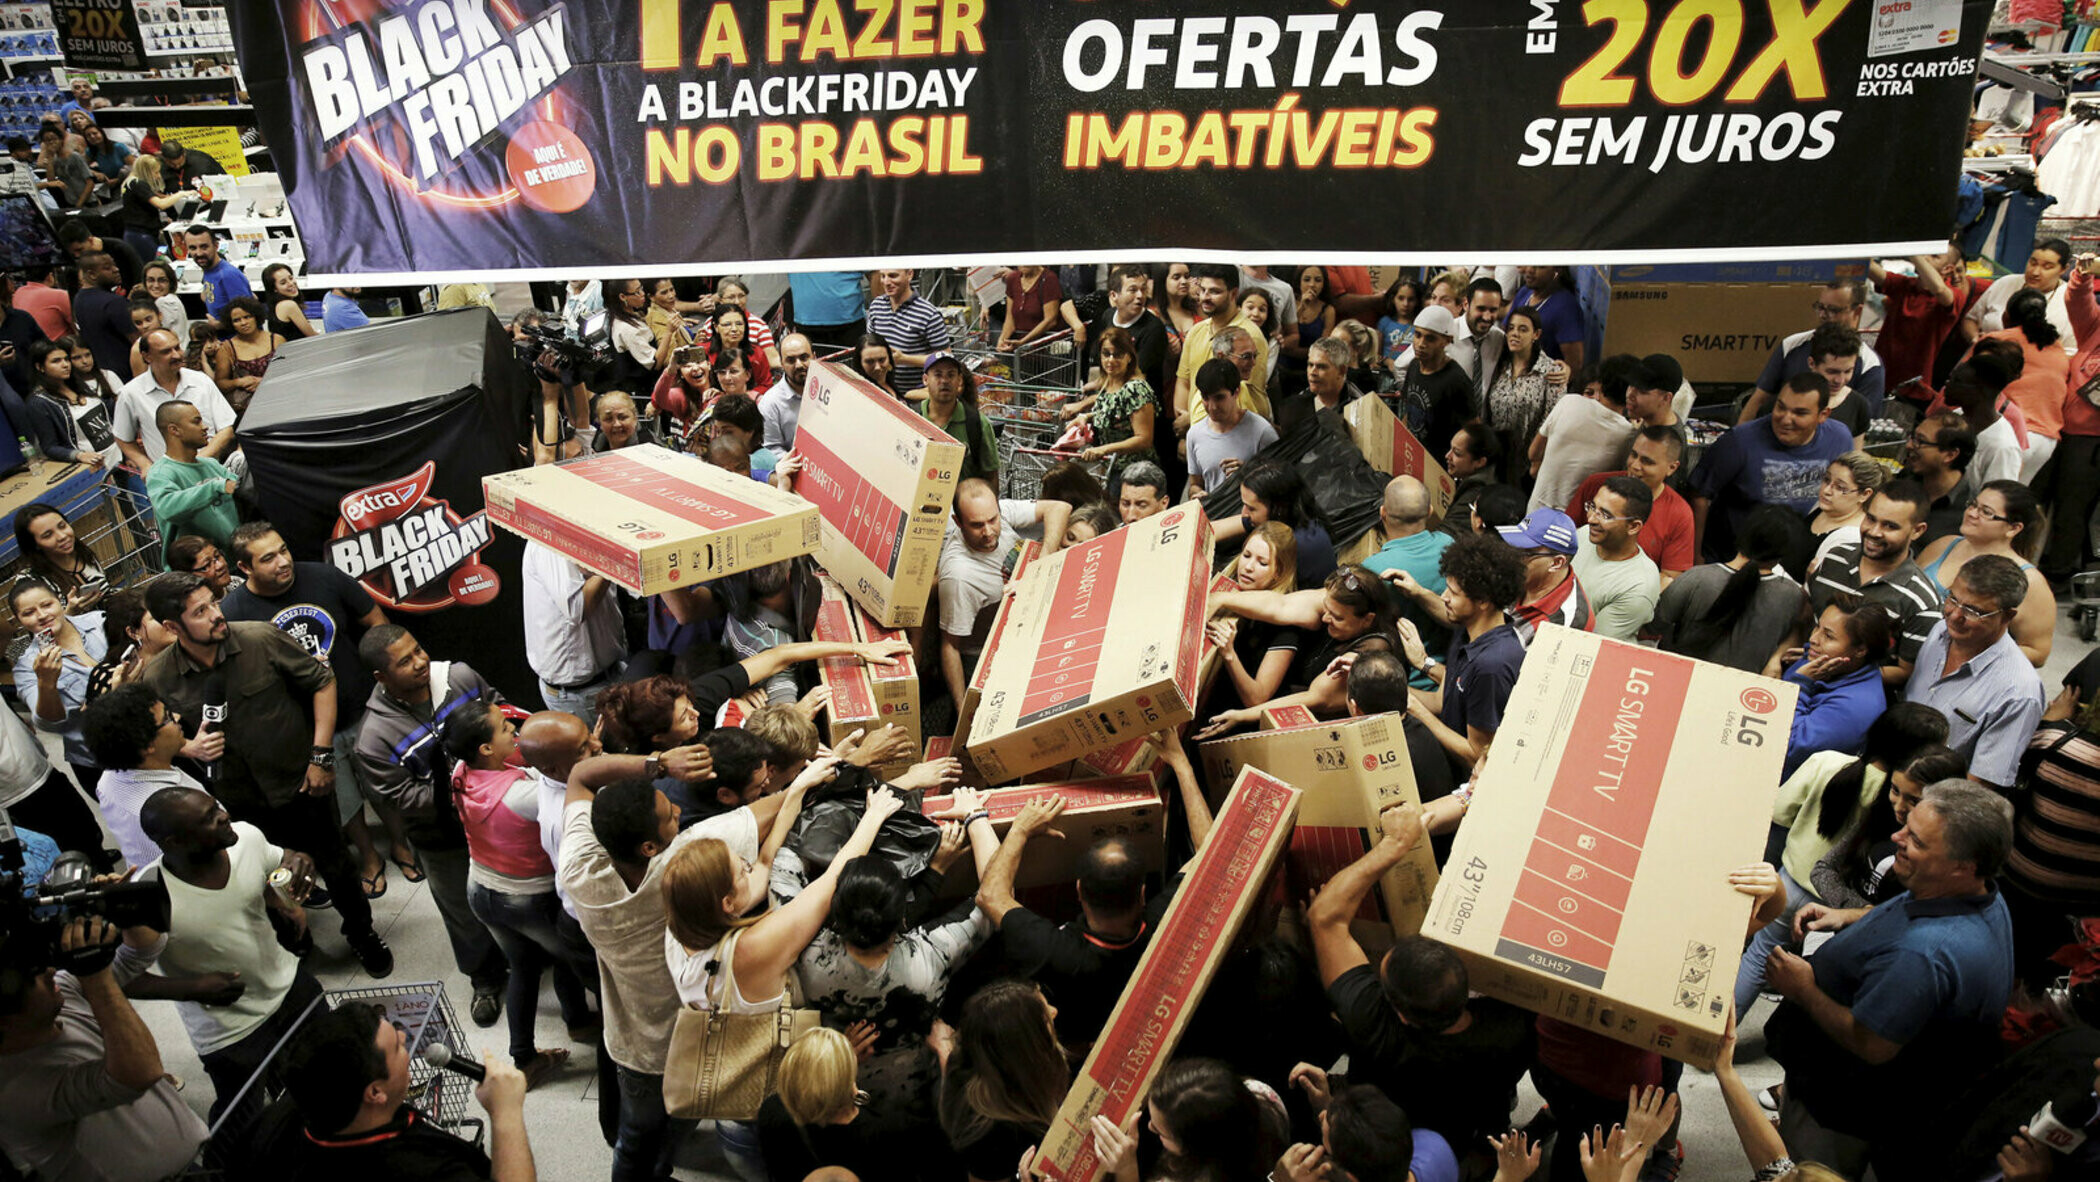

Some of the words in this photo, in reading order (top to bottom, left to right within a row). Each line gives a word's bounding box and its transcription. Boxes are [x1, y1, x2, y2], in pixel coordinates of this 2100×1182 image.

[1880, 1, 1912, 15] extra
[68, 10, 127, 39] 20X
[698, 2, 748, 67] A
[767, 0, 986, 64] FAZER
[67, 38, 95, 52] SEM
[97, 40, 135, 54] JUROS
[1062, 10, 1444, 92] OFERTAS
[1559, 0, 1850, 107] 20X
[303, 0, 501, 142] BLACK
[1860, 63, 1898, 79] NOS
[1901, 56, 1976, 78] CARTÕES
[403, 10, 572, 181] FRIDAY
[637, 84, 668, 122] A
[678, 67, 978, 120] BLACKFRIDAY
[1856, 79, 1914, 97] EXTRA
[1064, 94, 1440, 169] IMBATÍVEIS
[1517, 115, 1648, 167] SEM
[1648, 110, 1843, 174] JUROS
[532, 147, 559, 165] AQUI
[645, 126, 741, 186] NO
[757, 114, 983, 181] BRASIL
[524, 169, 541, 186] DE
[540, 158, 588, 184] VERDADE!
[1615, 291, 1668, 300] SAMSUNG
[1681, 335, 1749, 351] SMART
[1749, 335, 1778, 350] TV
[818, 385, 832, 406] LG
[938, 471, 951, 480] LG
[346, 490, 400, 521] extra
[616, 521, 647, 535] LG
[1161, 527, 1178, 545] LG
[331, 505, 451, 579] BLACK
[1086, 545, 1103, 563] LG
[390, 513, 490, 599] FRIDAY
[668, 552, 678, 569] LG
[1625, 667, 1655, 695] LG
[895, 702, 909, 712] LG
[1143, 707, 1159, 722] LG
[1604, 697, 1645, 769] SMART
[1737, 714, 1768, 748] LG
[1378, 750, 1397, 766] LG
[1593, 770, 1628, 803] TV
[1527, 953, 1573, 974] 43LH57
[1155, 994, 1176, 1019] LG
[1127, 1019, 1163, 1078] SMART
[1658, 1034, 1673, 1048] LG
[1112, 1078, 1137, 1103] TV
